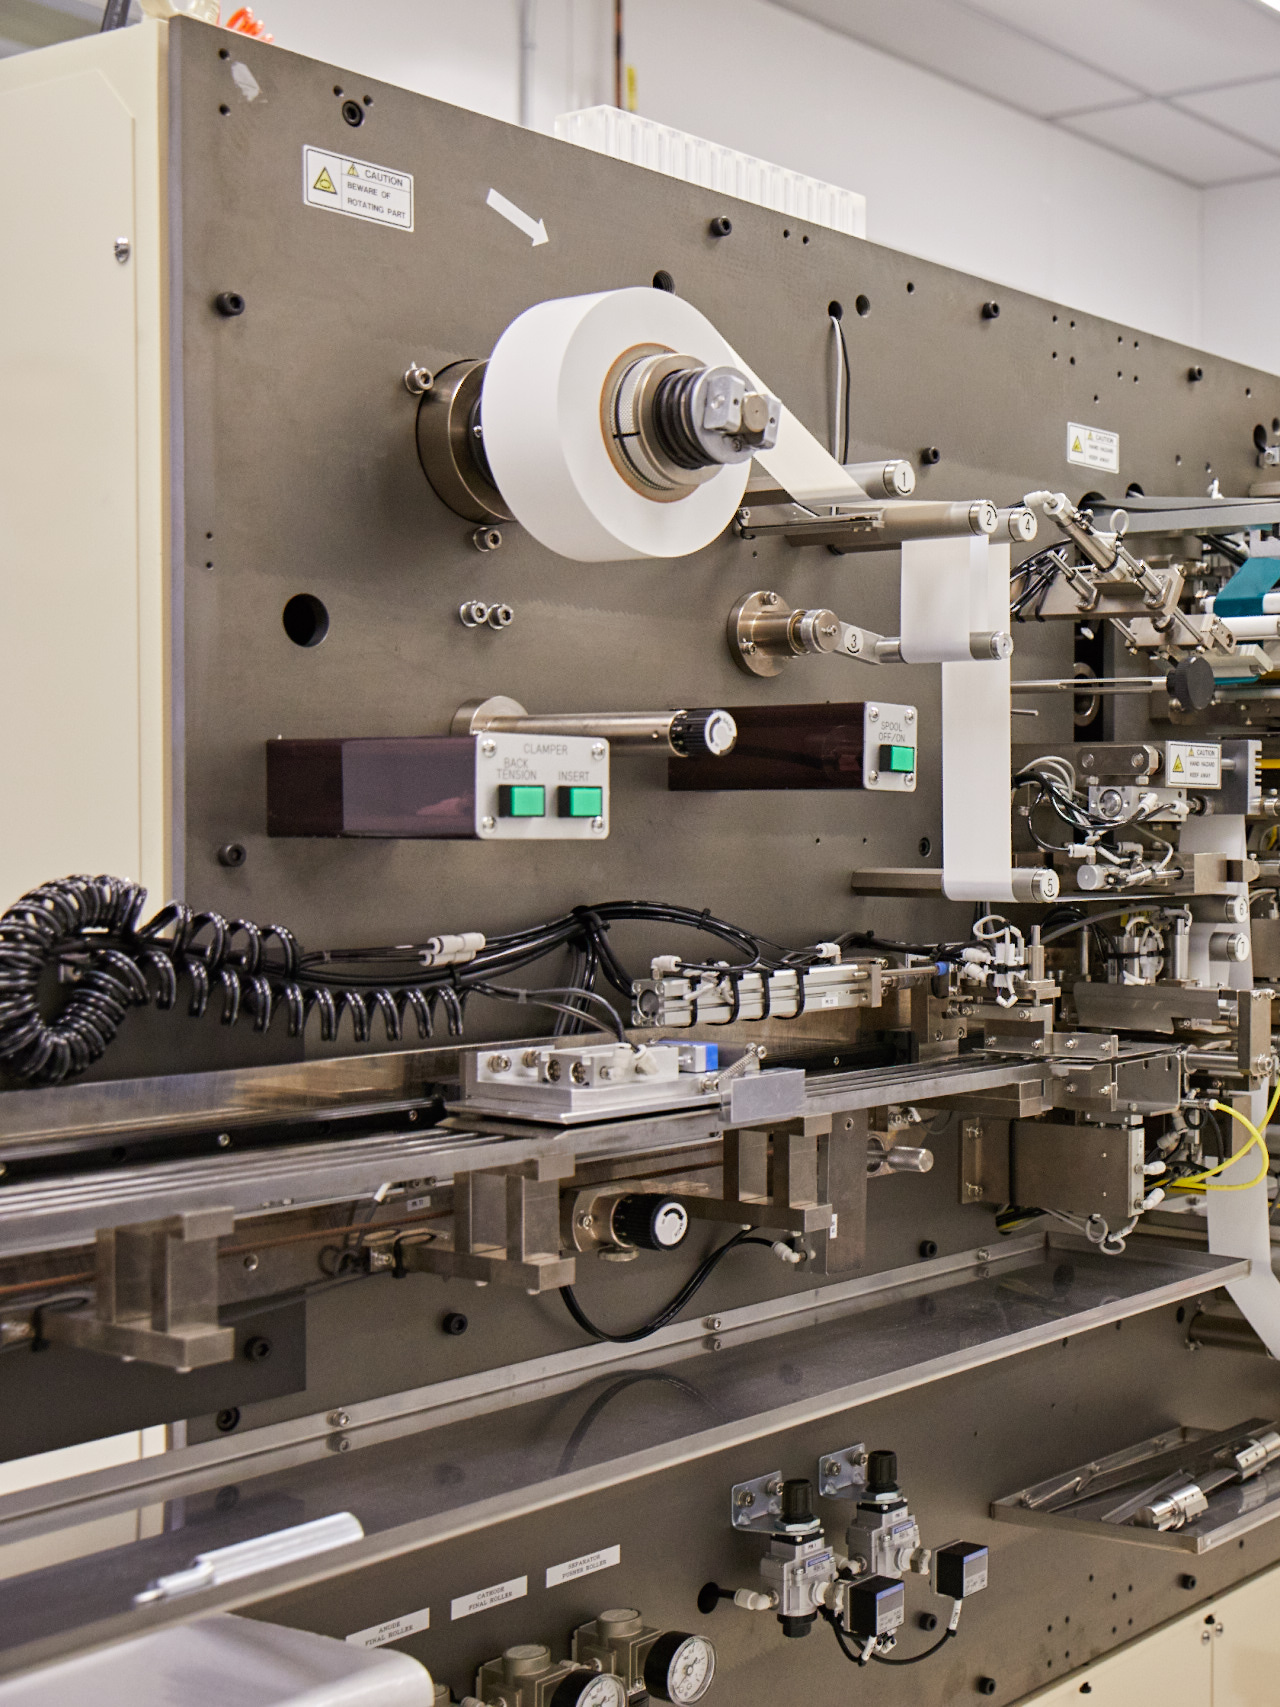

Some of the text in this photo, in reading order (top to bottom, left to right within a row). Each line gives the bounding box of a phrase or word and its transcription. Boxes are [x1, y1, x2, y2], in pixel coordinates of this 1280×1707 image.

[365, 169, 403, 187] CAUTION
[347, 181, 391, 200] BEWARE OF
[347, 197, 406, 219] ROTATING PART
[986, 510, 992, 526] 2
[1025, 518, 1031, 533] 4
[850, 633, 857, 649] 3
[880, 721, 903, 732] SPOOL
[878, 732, 906, 743] OFF/ON
[523, 743, 569, 756] CLAMPER
[1196, 749, 1216, 757] CAUTION
[503, 757, 529, 769] BACK
[497, 768, 537, 780] TENSION
[558, 771, 590, 782] INSERT
[1047, 878, 1053, 893] 5
[1239, 902, 1245, 916] 6
[1240, 941, 1245, 955] 7
[567, 1554, 600, 1570] SEPARATOR
[476, 1586, 505, 1600] CATHODE
[468, 1601, 488, 1611] FINAL
[378, 1621, 401, 1633] ANODE
[365, 1635, 386, 1647] FINAL
